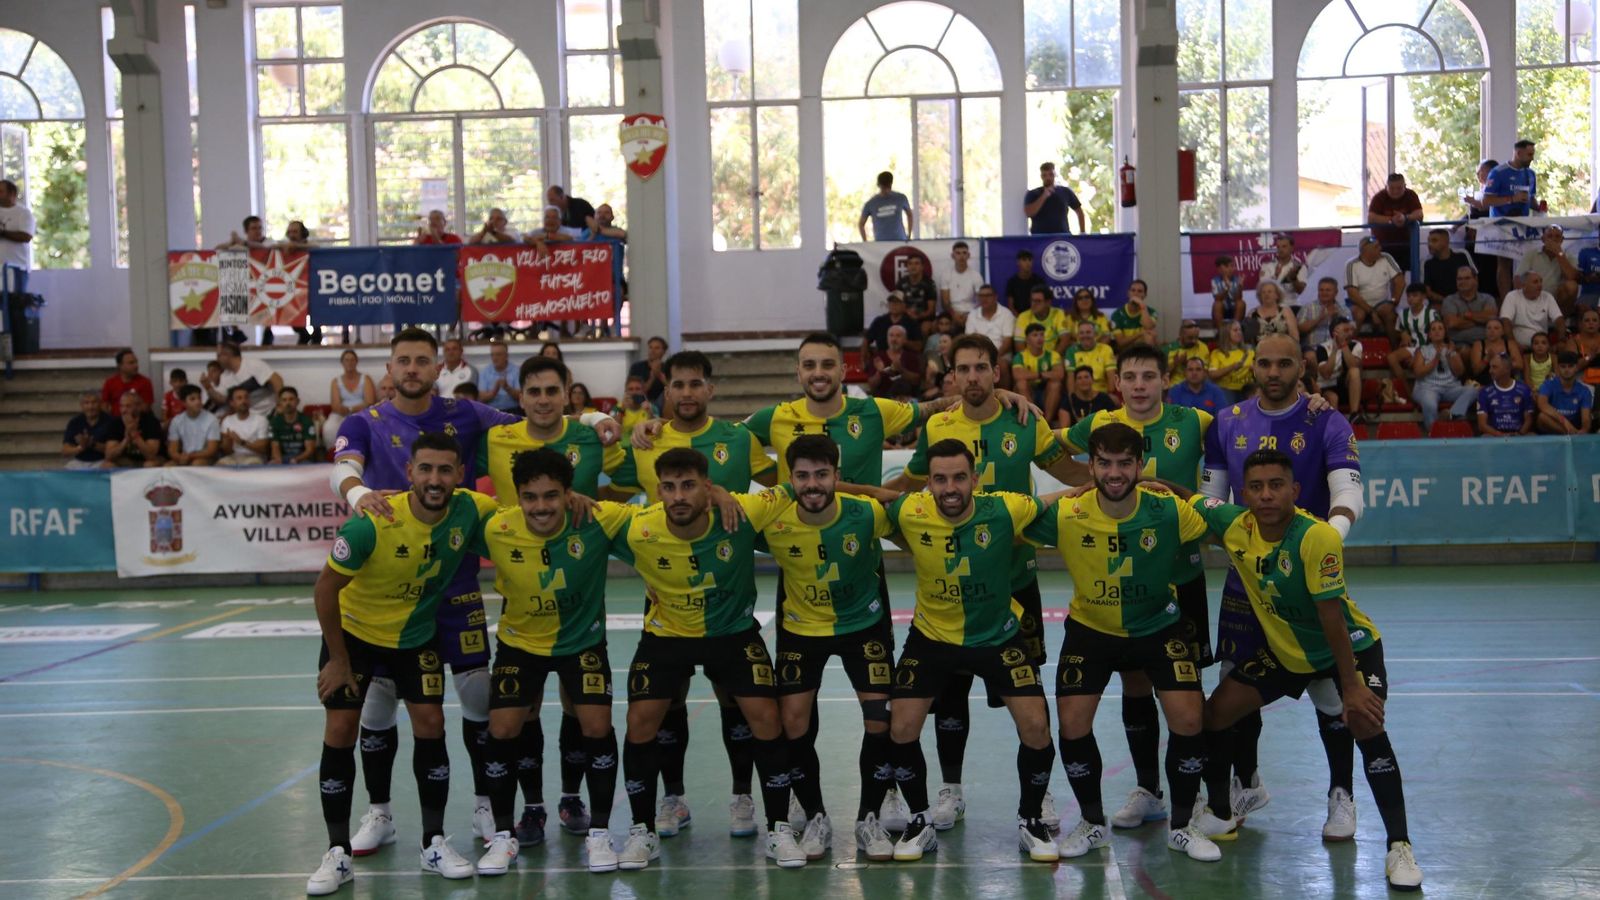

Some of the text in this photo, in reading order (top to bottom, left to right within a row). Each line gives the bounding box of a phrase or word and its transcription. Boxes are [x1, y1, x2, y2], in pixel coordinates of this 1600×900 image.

[553, 248, 577, 266] DEL
[317, 268, 445, 294] Beconet
[540, 272, 584, 293] FUTSAL
[329, 297, 355, 306] FIBRA
[362, 296, 382, 304] FIJO
[421, 295, 434, 303] TV
[515, 290, 610, 319] #HEMOSVUELTO
[973, 439, 989, 457] 14
[1259, 435, 1278, 450] 28
[1462, 473, 1549, 506] RFAF
[10, 508, 84, 536] RFAF
[243, 526, 301, 542] VILLA
[945, 535, 961, 553] 21
[1108, 535, 1128, 552] 55
[541, 548, 551, 566] 8
[818, 544, 829, 560] 6
[688, 555, 700, 570] 9
[1256, 556, 1272, 575] 12
[465, 634, 480, 646] LZ
[757, 667, 770, 679] LZ
[873, 666, 886, 677] LZ
[1015, 668, 1031, 680] LZ
[1178, 664, 1193, 675] LZ
[426, 678, 440, 689] LZ
[586, 677, 600, 687] LZ
